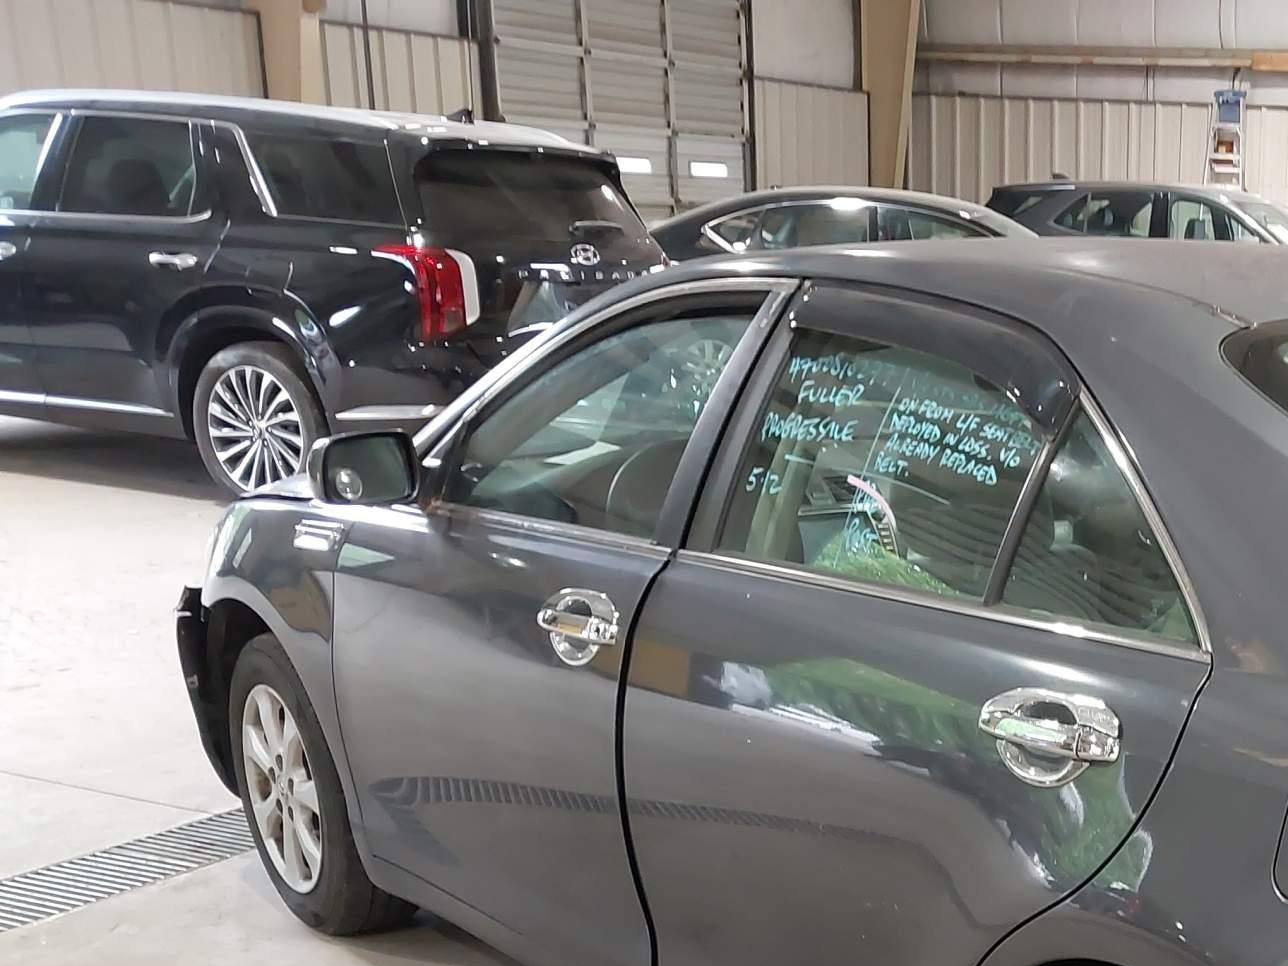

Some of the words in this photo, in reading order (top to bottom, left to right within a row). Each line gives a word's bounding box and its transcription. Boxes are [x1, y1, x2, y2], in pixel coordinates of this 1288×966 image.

[797, 379, 865, 408] FULLER
[889, 412, 941, 444] DEPLOYED
[942, 431, 960, 447] IN
[918, 398, 955, 425] FROM
[956, 413, 981, 436] L/F
[979, 421, 1014, 443] SEAT
[884, 432, 941, 466] ALREADY
[939, 447, 998, 487] REPLACED
